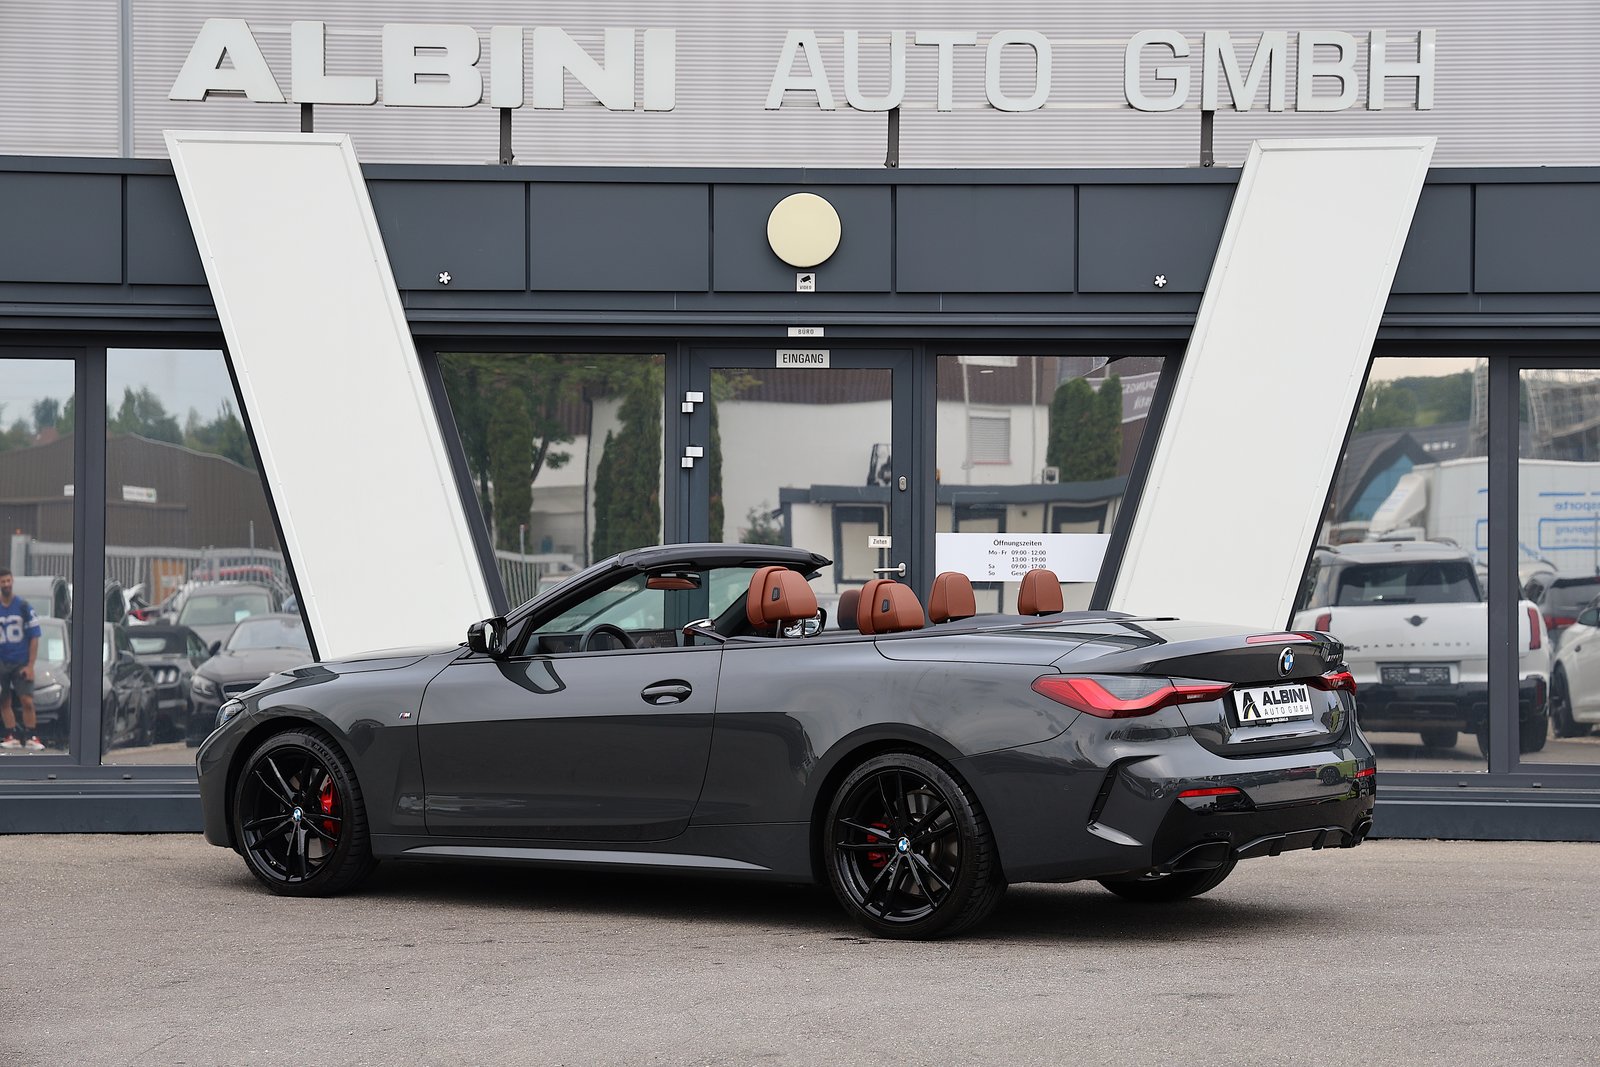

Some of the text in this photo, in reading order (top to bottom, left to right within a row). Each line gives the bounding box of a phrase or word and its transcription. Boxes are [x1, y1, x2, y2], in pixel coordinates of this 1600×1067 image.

[168, 18, 1436, 112] ALBINI AUTO GMBH
[782, 353, 824, 364] EINGANG
[993, 539, 1043, 547] Öffnungszeiten
[1263, 688, 1307, 706] ALBINI
[1264, 705, 1310, 716] AUTO GMBH
